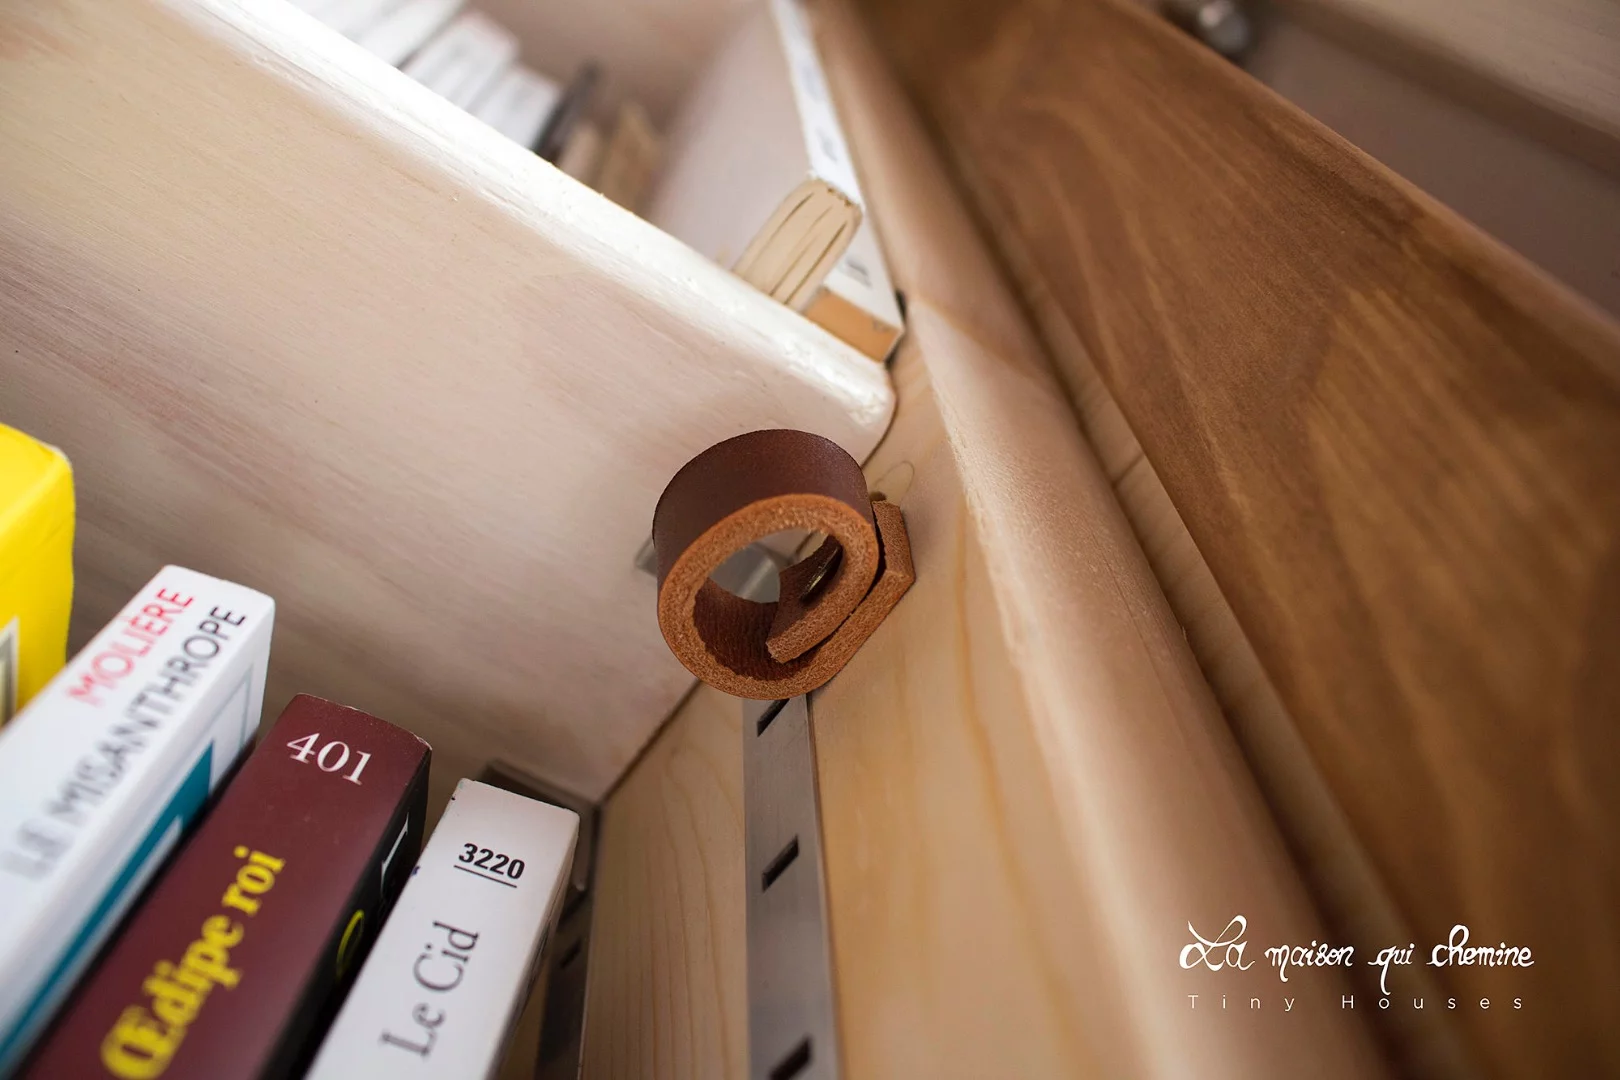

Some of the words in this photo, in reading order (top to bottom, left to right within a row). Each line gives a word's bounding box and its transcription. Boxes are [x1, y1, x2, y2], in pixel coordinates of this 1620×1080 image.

[46, 605, 246, 838] MISANTHROPE
[286, 732, 372, 786] 401
[222, 845, 286, 917] roi
[458, 842, 525, 880] 3220
[379, 1002, 446, 1060] Le
[413, 920, 480, 992] Cid
